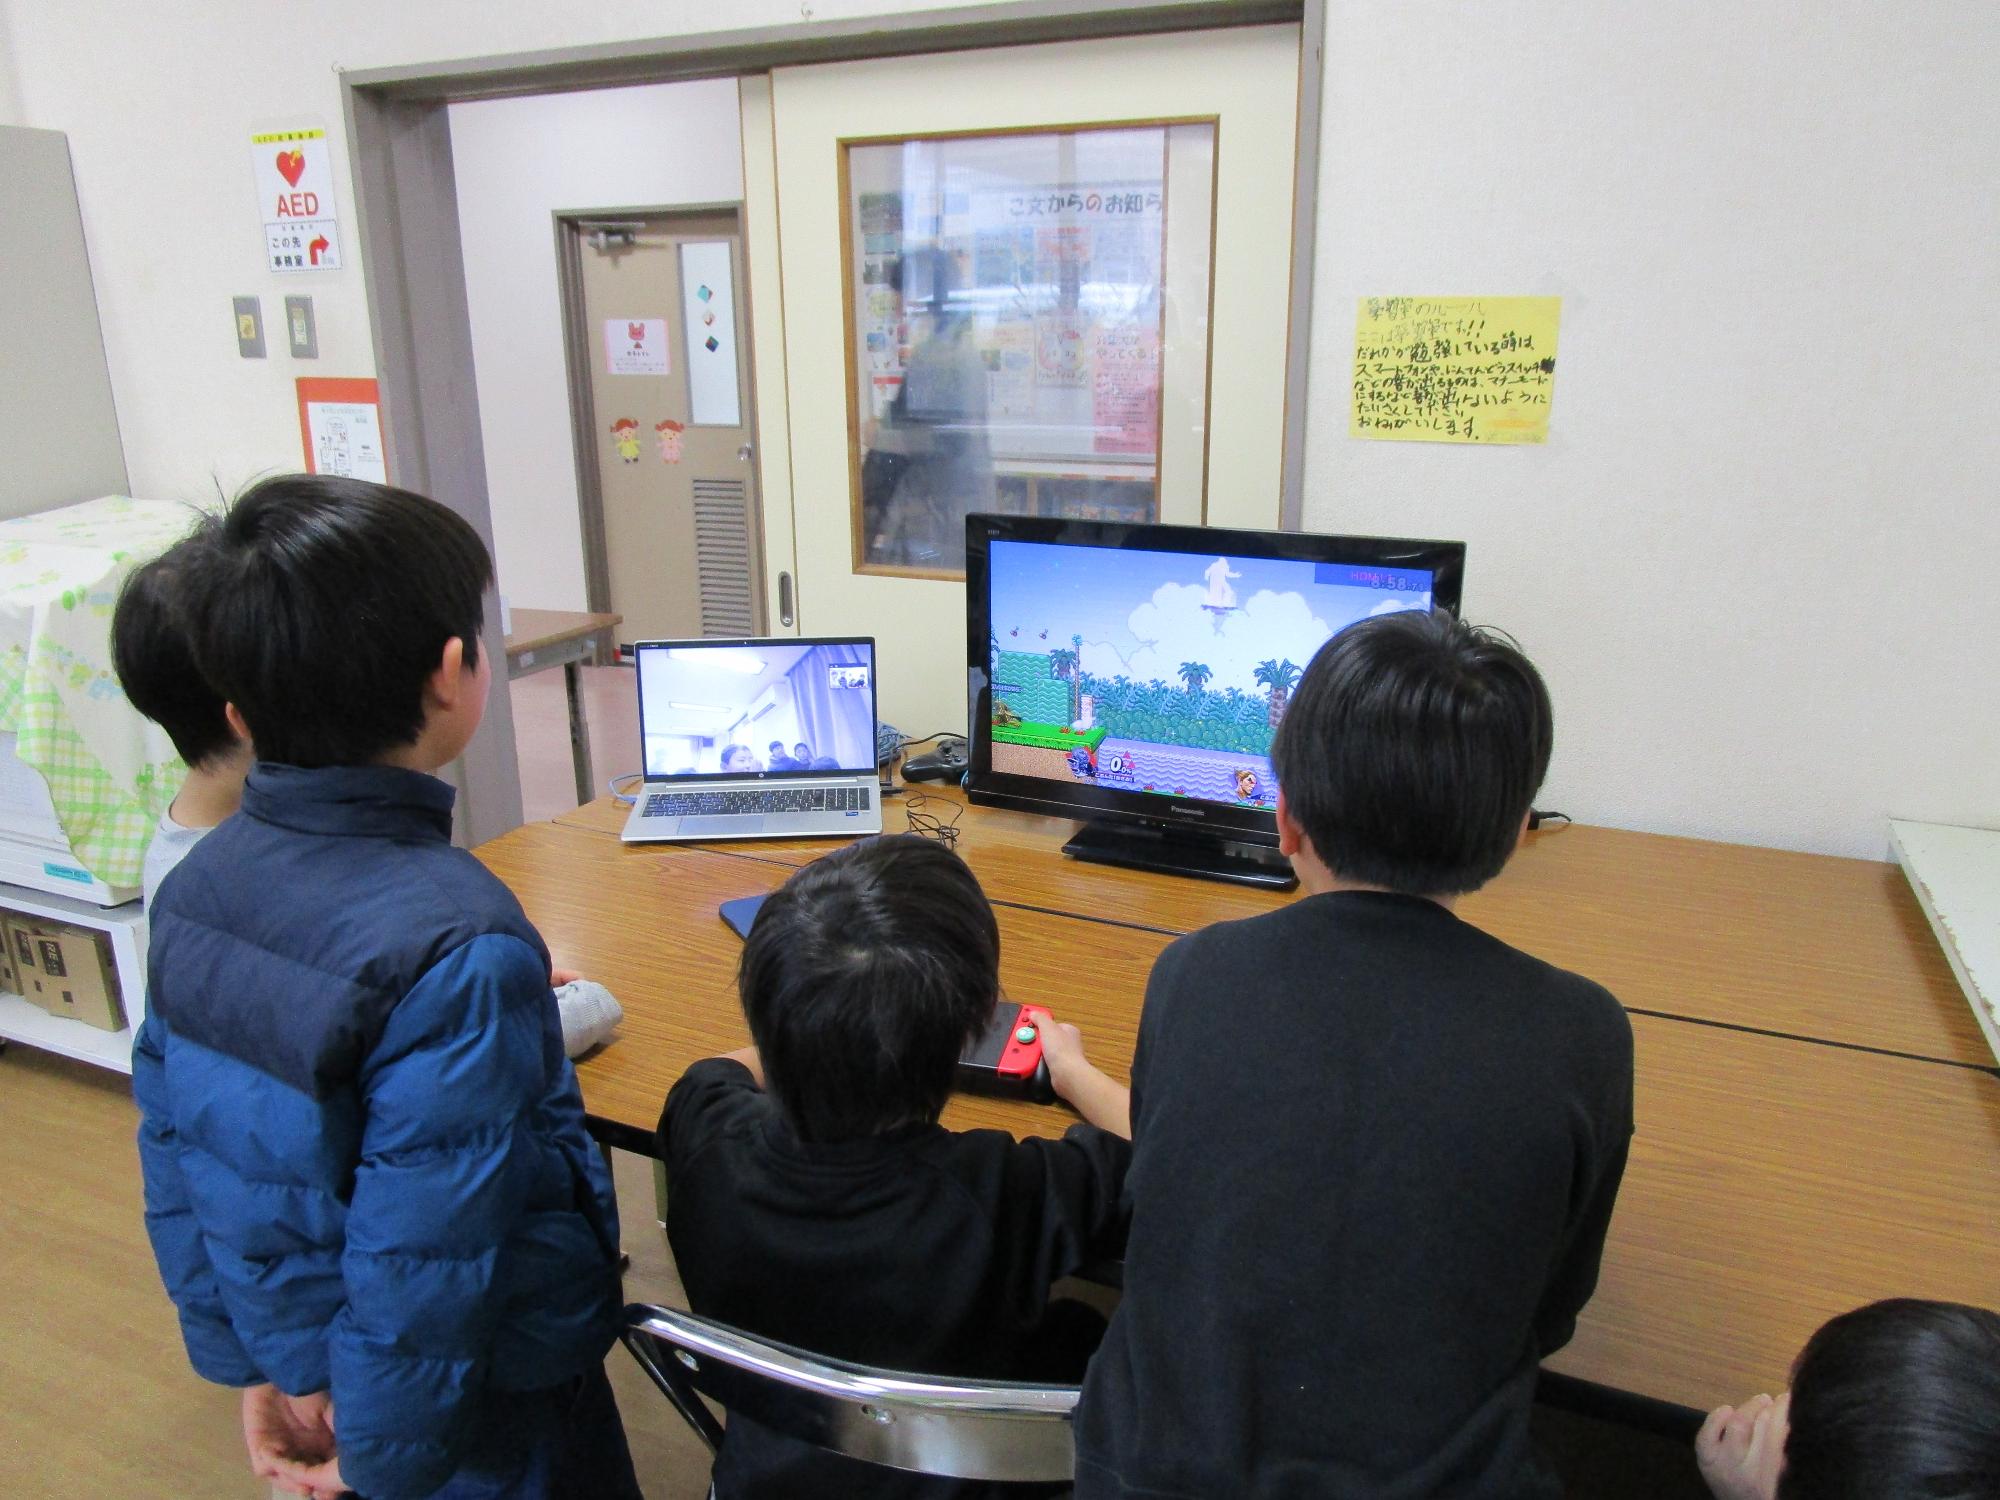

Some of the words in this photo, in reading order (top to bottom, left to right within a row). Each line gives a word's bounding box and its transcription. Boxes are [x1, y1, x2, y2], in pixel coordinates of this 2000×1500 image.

[277, 192, 319, 217] AED
[273, 236, 302, 248] この先
